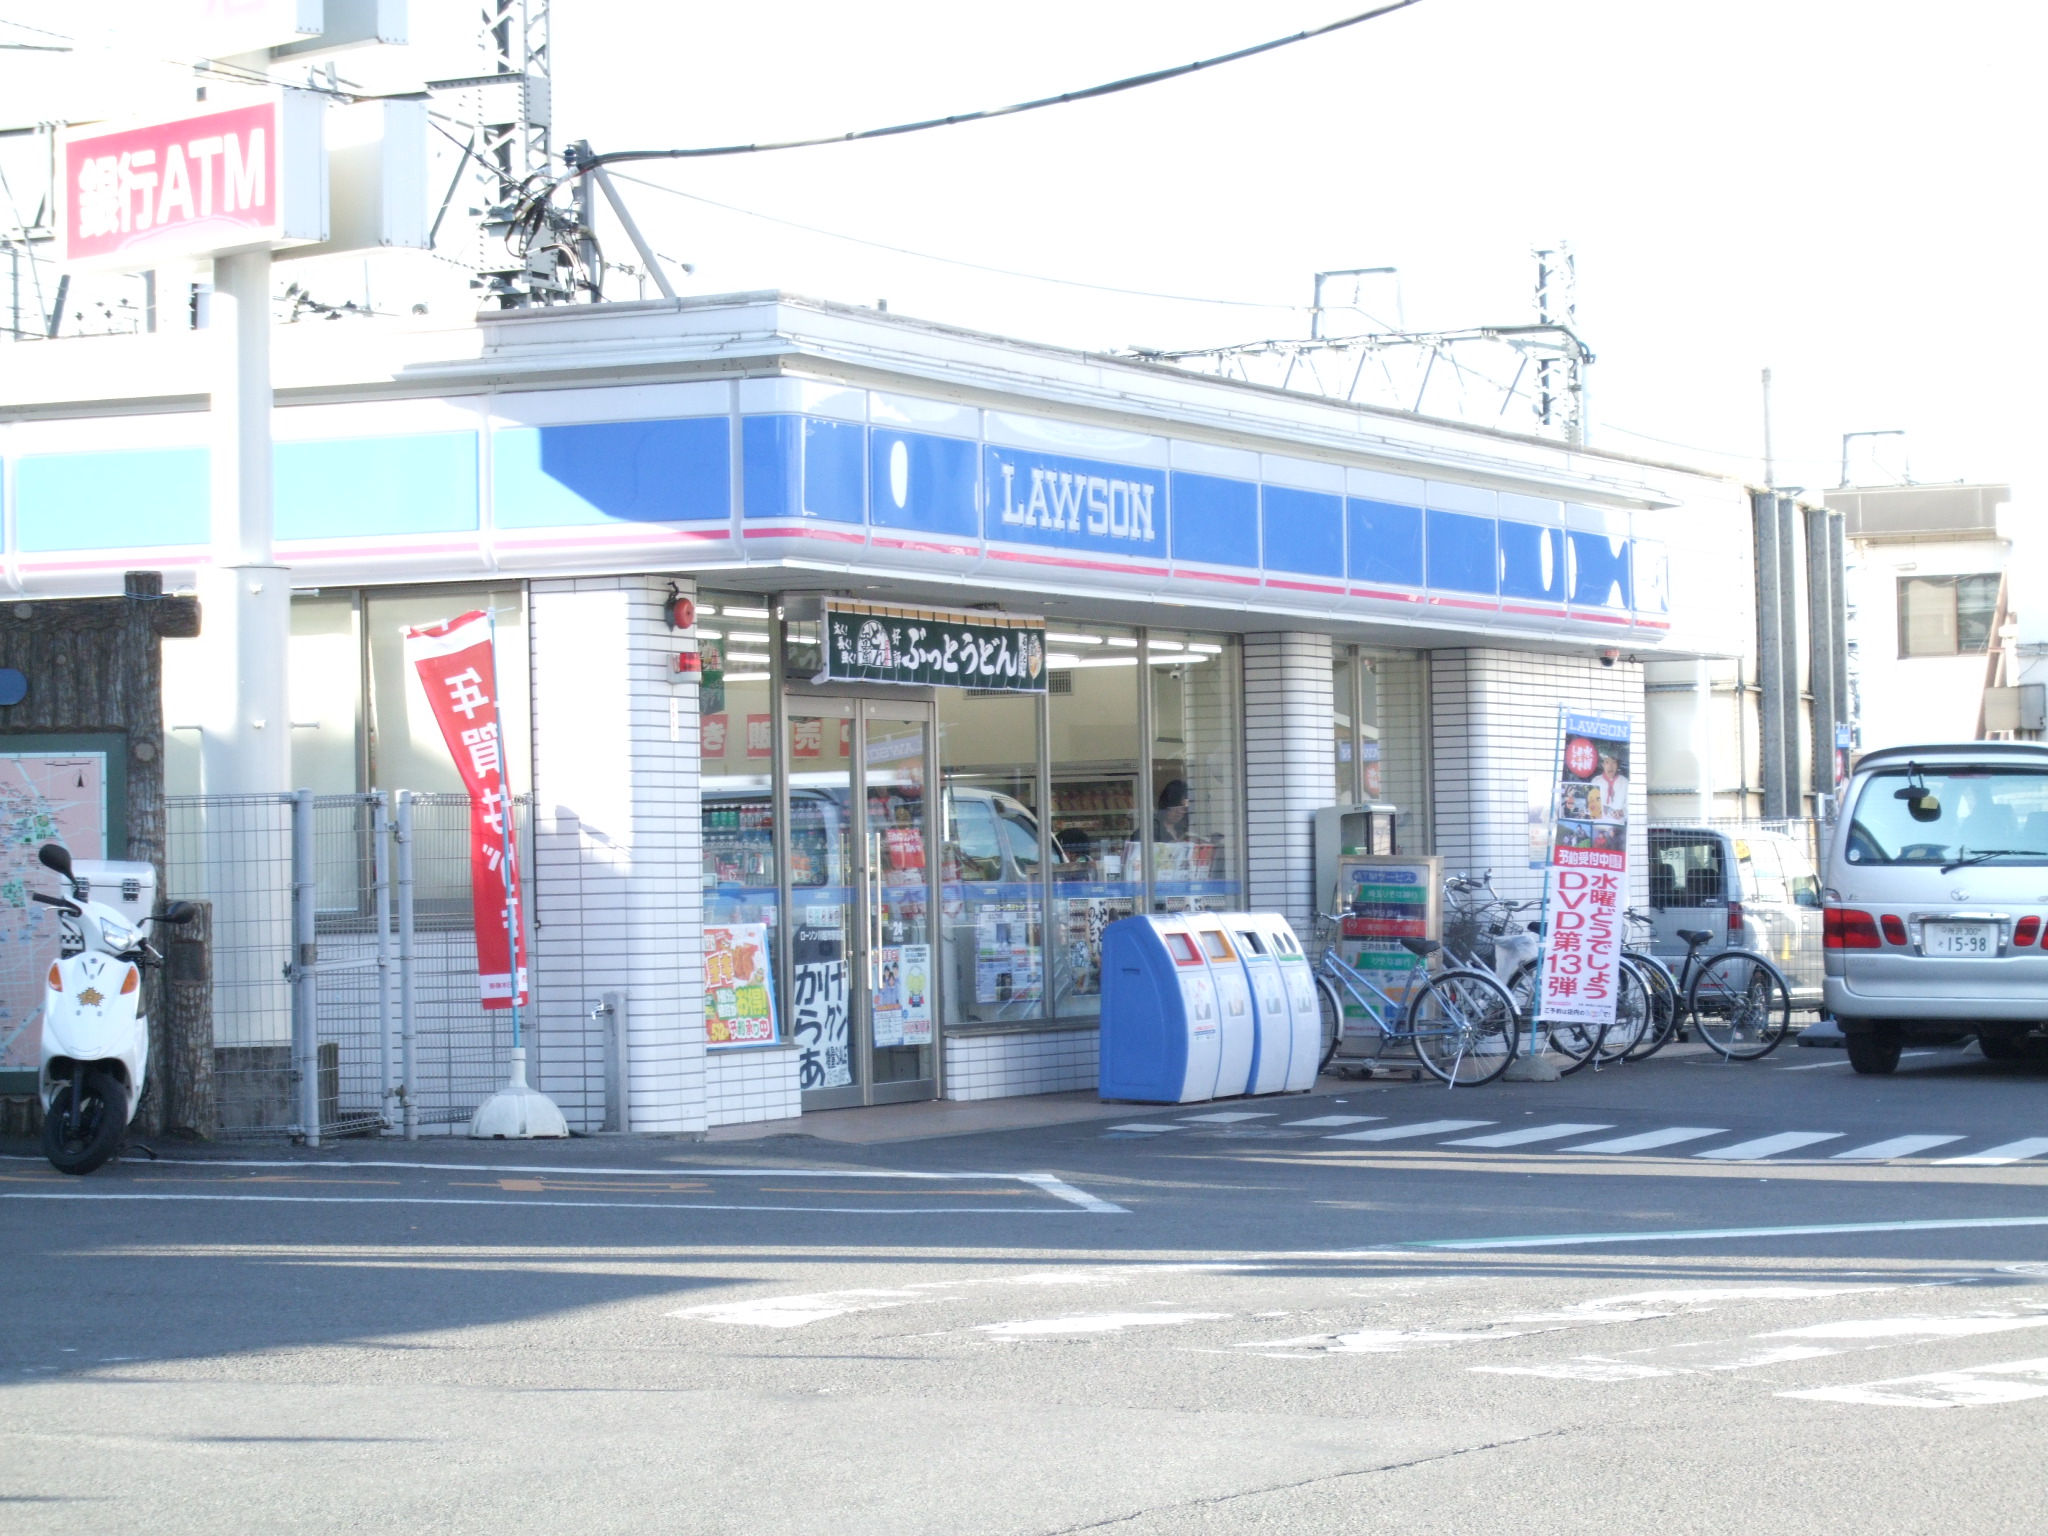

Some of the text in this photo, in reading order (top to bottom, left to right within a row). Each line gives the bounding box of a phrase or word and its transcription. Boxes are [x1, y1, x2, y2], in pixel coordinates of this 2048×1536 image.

[79, 127, 265, 238] 銀行ATM
[1002, 464, 1155, 541] LAWSON
[902, 627, 1018, 677] ぶっとうどん
[1568, 717, 1629, 739] LAWSON
[1558, 849, 1609, 868] 予約受付中
[893, 921, 903, 936] 24
[1547, 871, 1589, 998] DVD第13弾
[1583, 874, 1618, 1000] 水曜どうでしょう
[1948, 937, 1987, 952] 15-98
